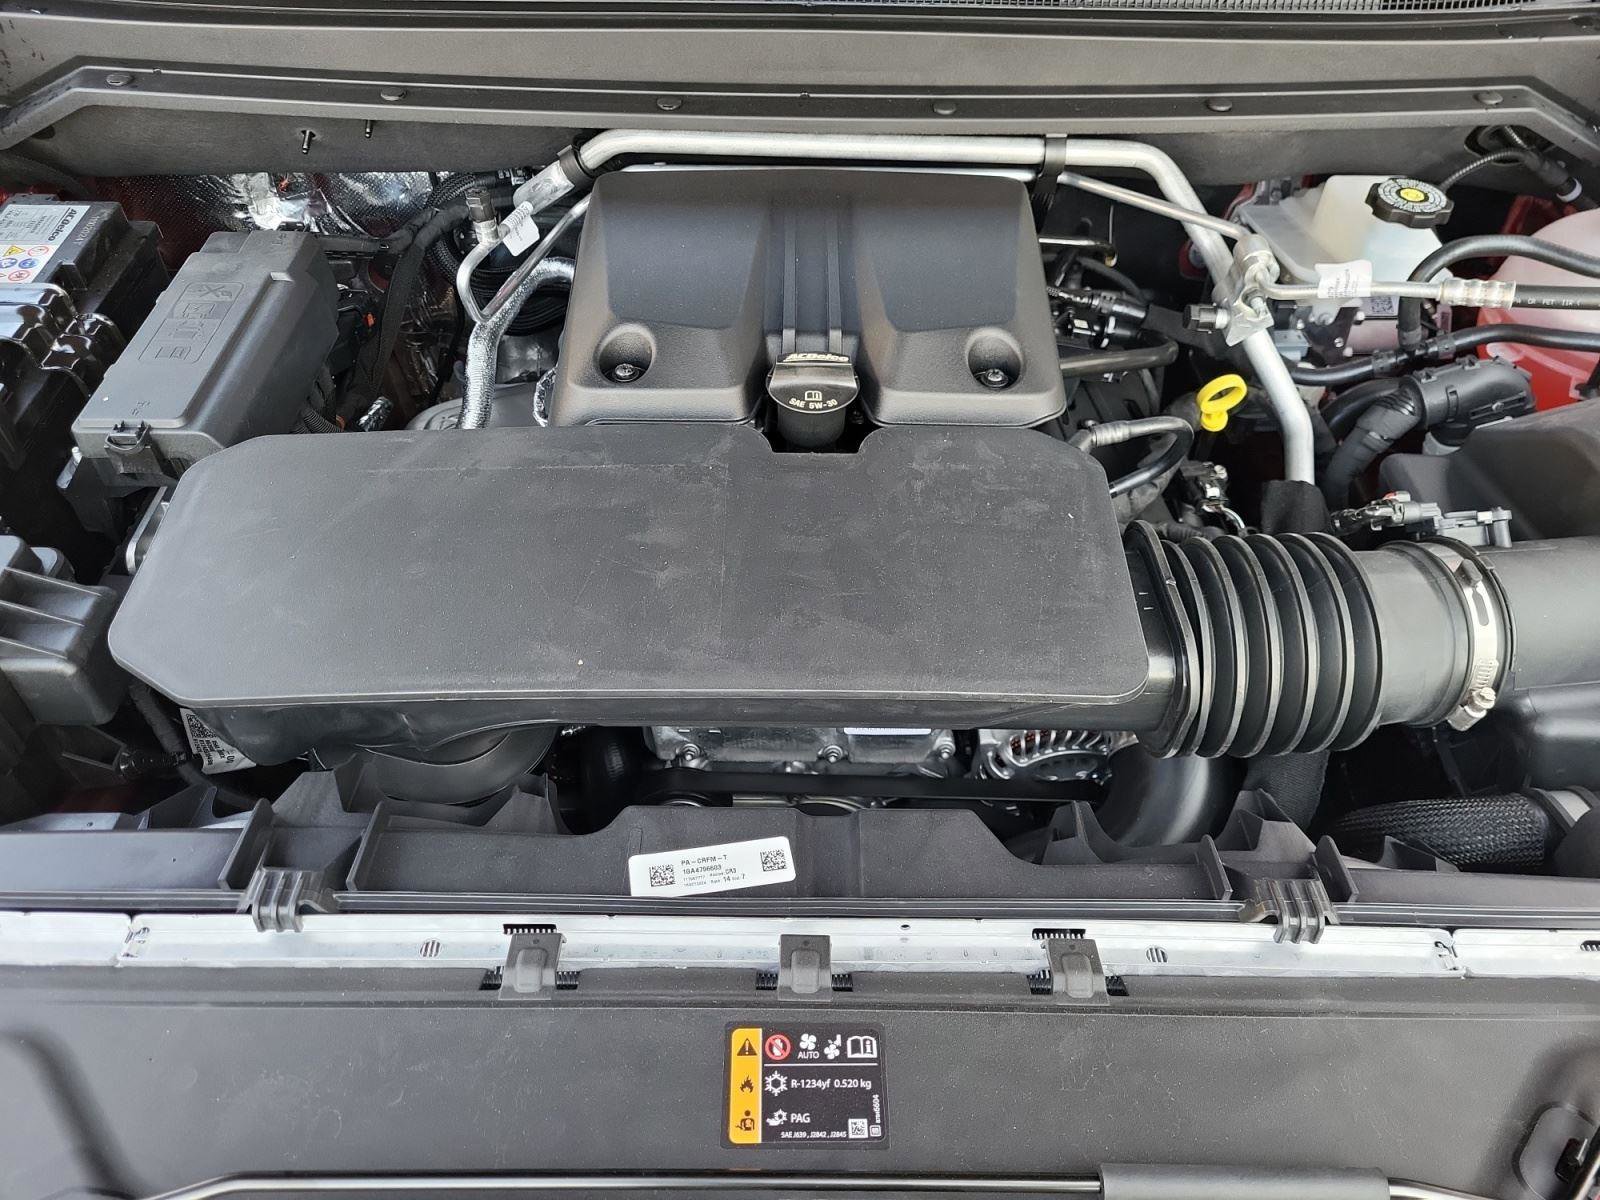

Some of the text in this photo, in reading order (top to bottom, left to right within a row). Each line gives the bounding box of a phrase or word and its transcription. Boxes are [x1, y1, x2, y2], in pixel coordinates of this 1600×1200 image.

[48, 208, 77, 241] ACDelco
[788, 397, 838, 409] SAE 5W-30
[797, 1051, 819, 1059] AUTO
[790, 1078, 872, 1090] R-1234yf 0.520 kg
[790, 1112, 811, 1123] PAG
[780, 1131, 793, 1139] SAE
